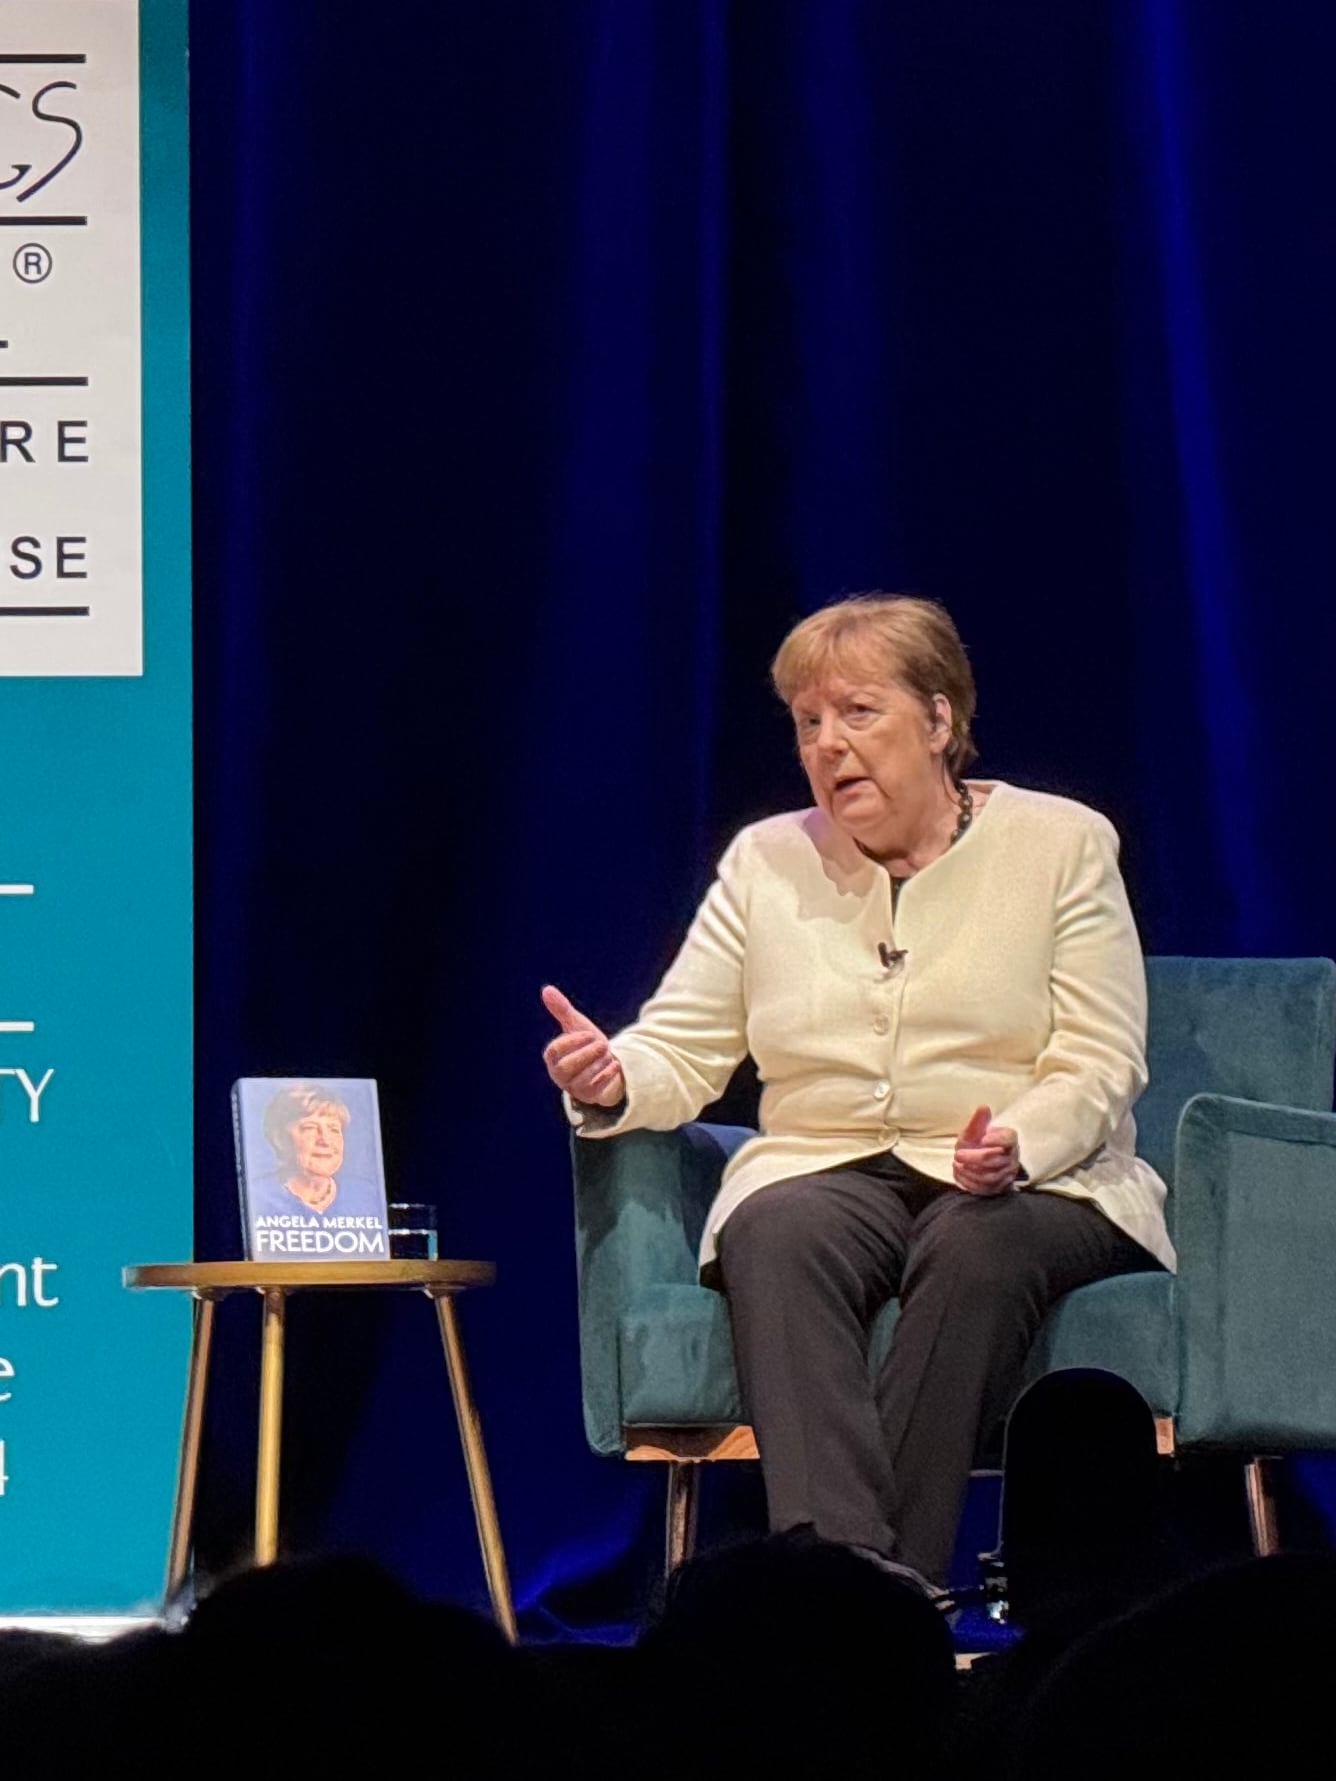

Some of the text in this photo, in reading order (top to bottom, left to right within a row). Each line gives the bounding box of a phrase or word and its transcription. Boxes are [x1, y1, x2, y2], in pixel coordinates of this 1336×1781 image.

[255, 1215, 383, 1229] ANGELA MERKEL
[255, 1230, 385, 1253] FREEDOM
